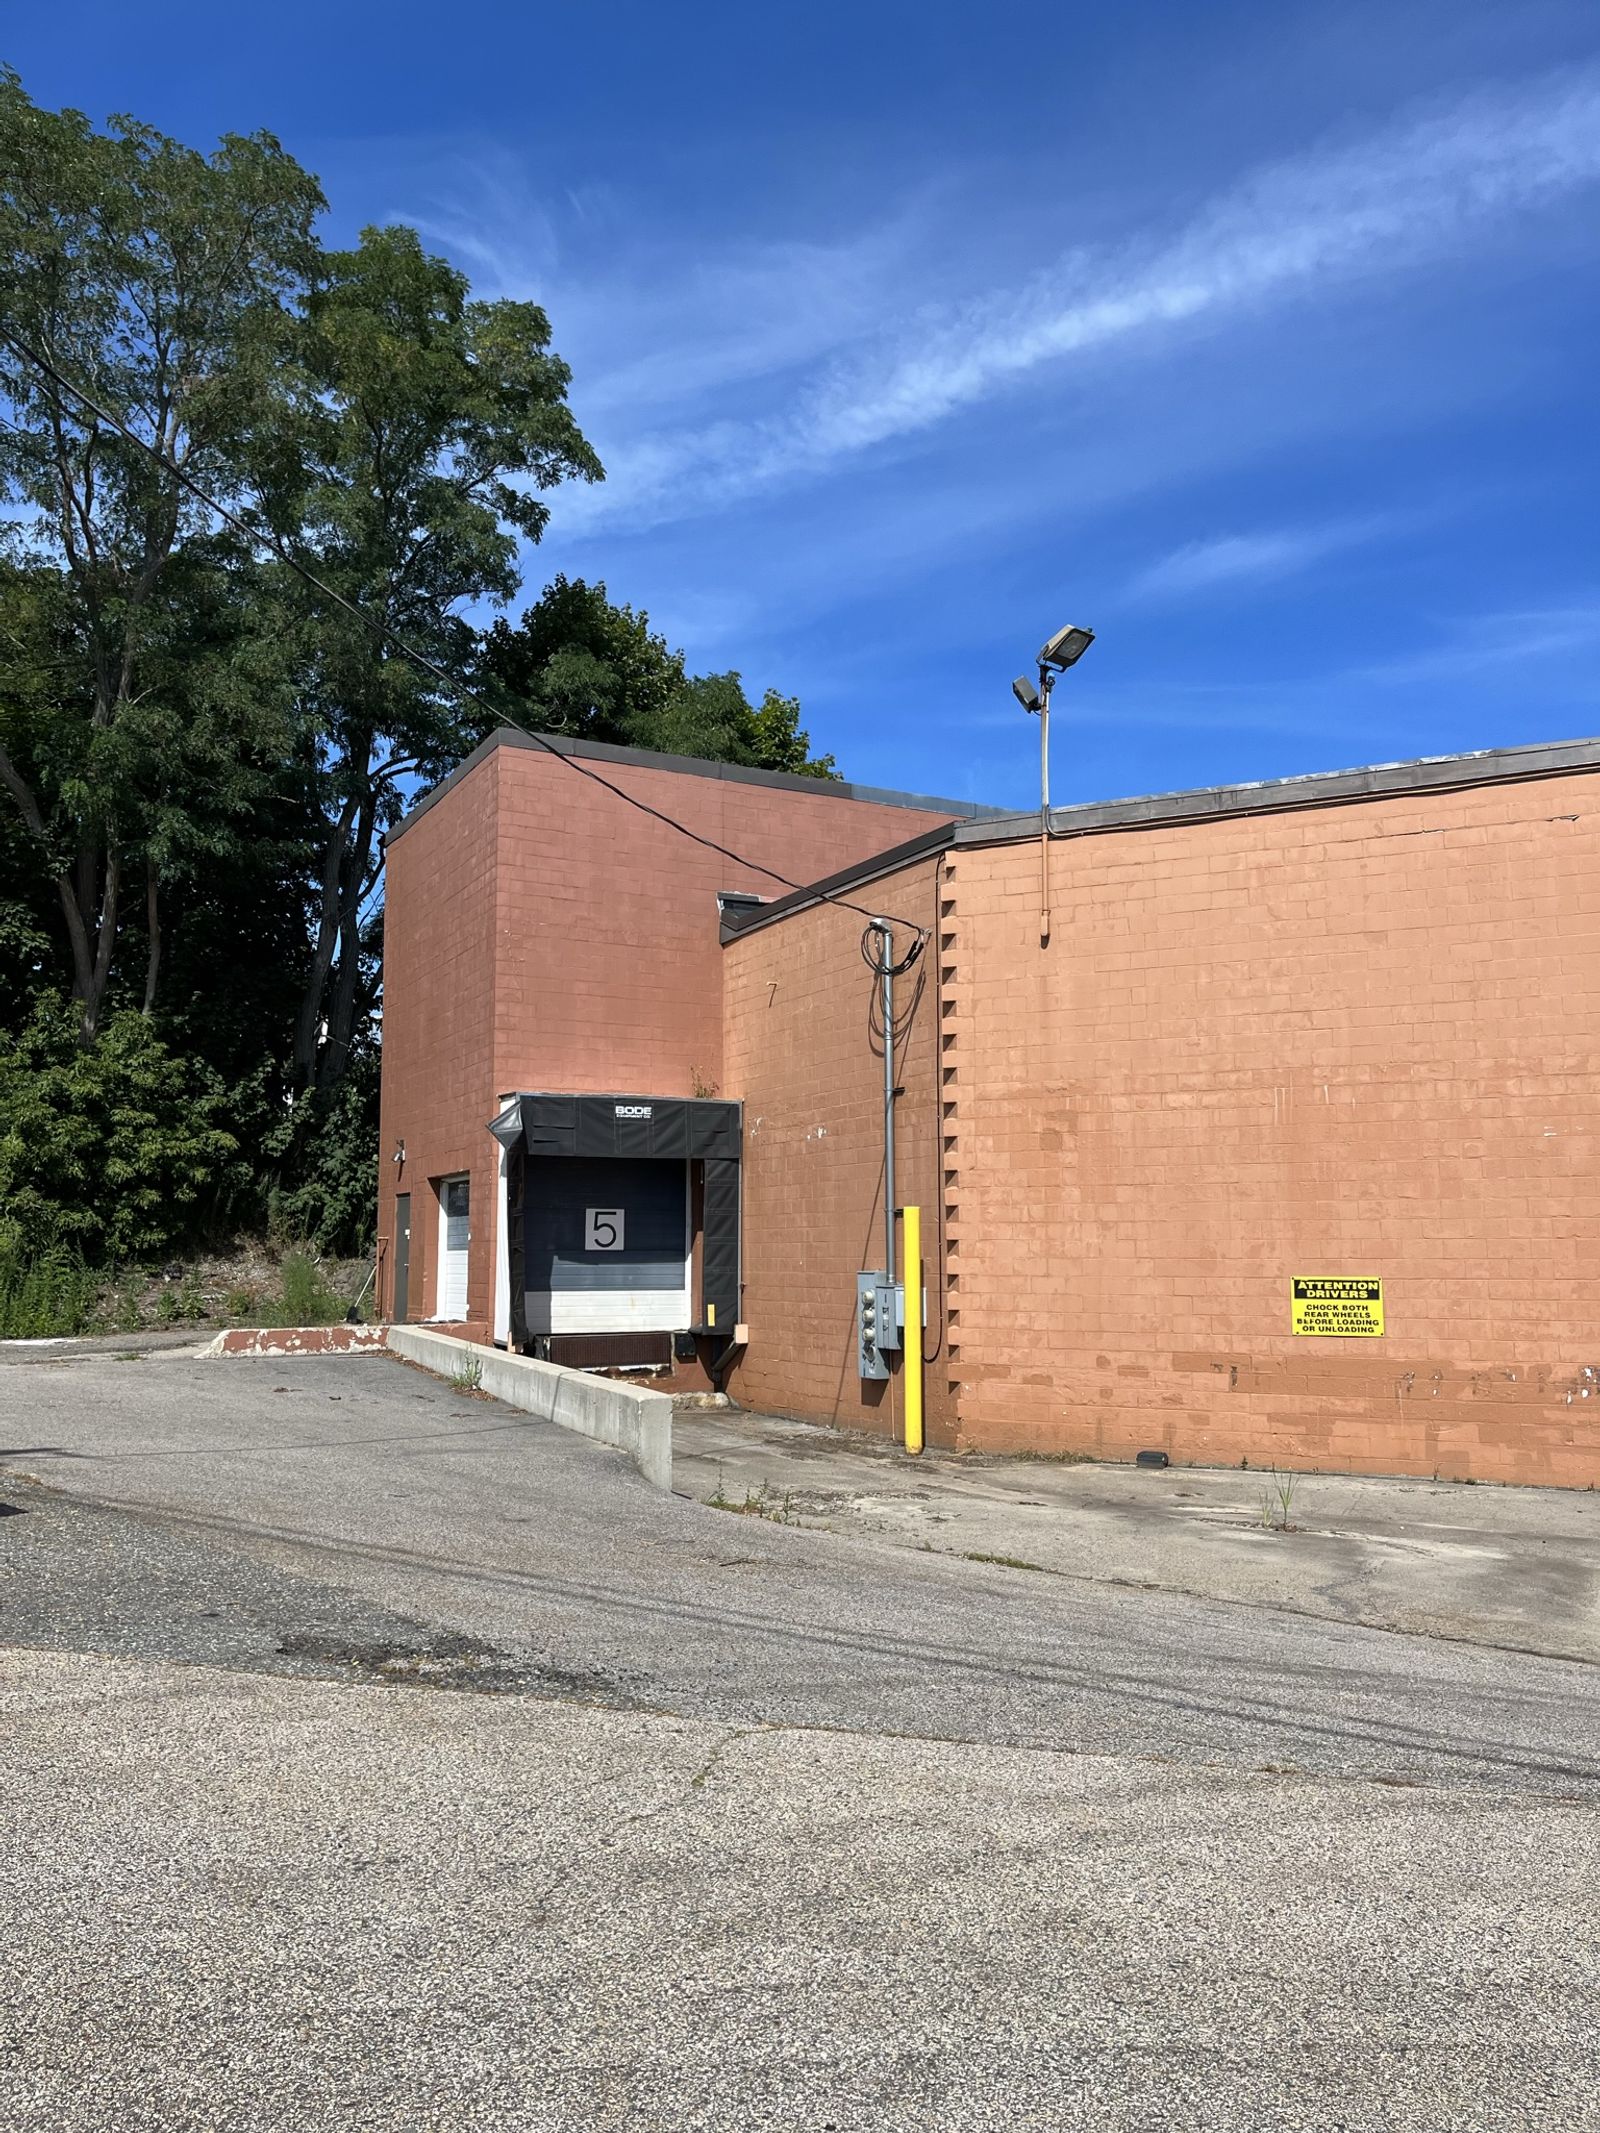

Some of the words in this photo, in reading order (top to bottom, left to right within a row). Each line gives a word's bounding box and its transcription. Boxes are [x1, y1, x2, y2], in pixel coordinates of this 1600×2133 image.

[615, 1105, 652, 1115] BODE
[594, 1211, 617, 1248] 5
[1298, 1281, 1378, 1290] ATTENTION
[1306, 1290, 1368, 1298] DRIVERS
[1318, 1325, 1375, 1333] UNLOADING
